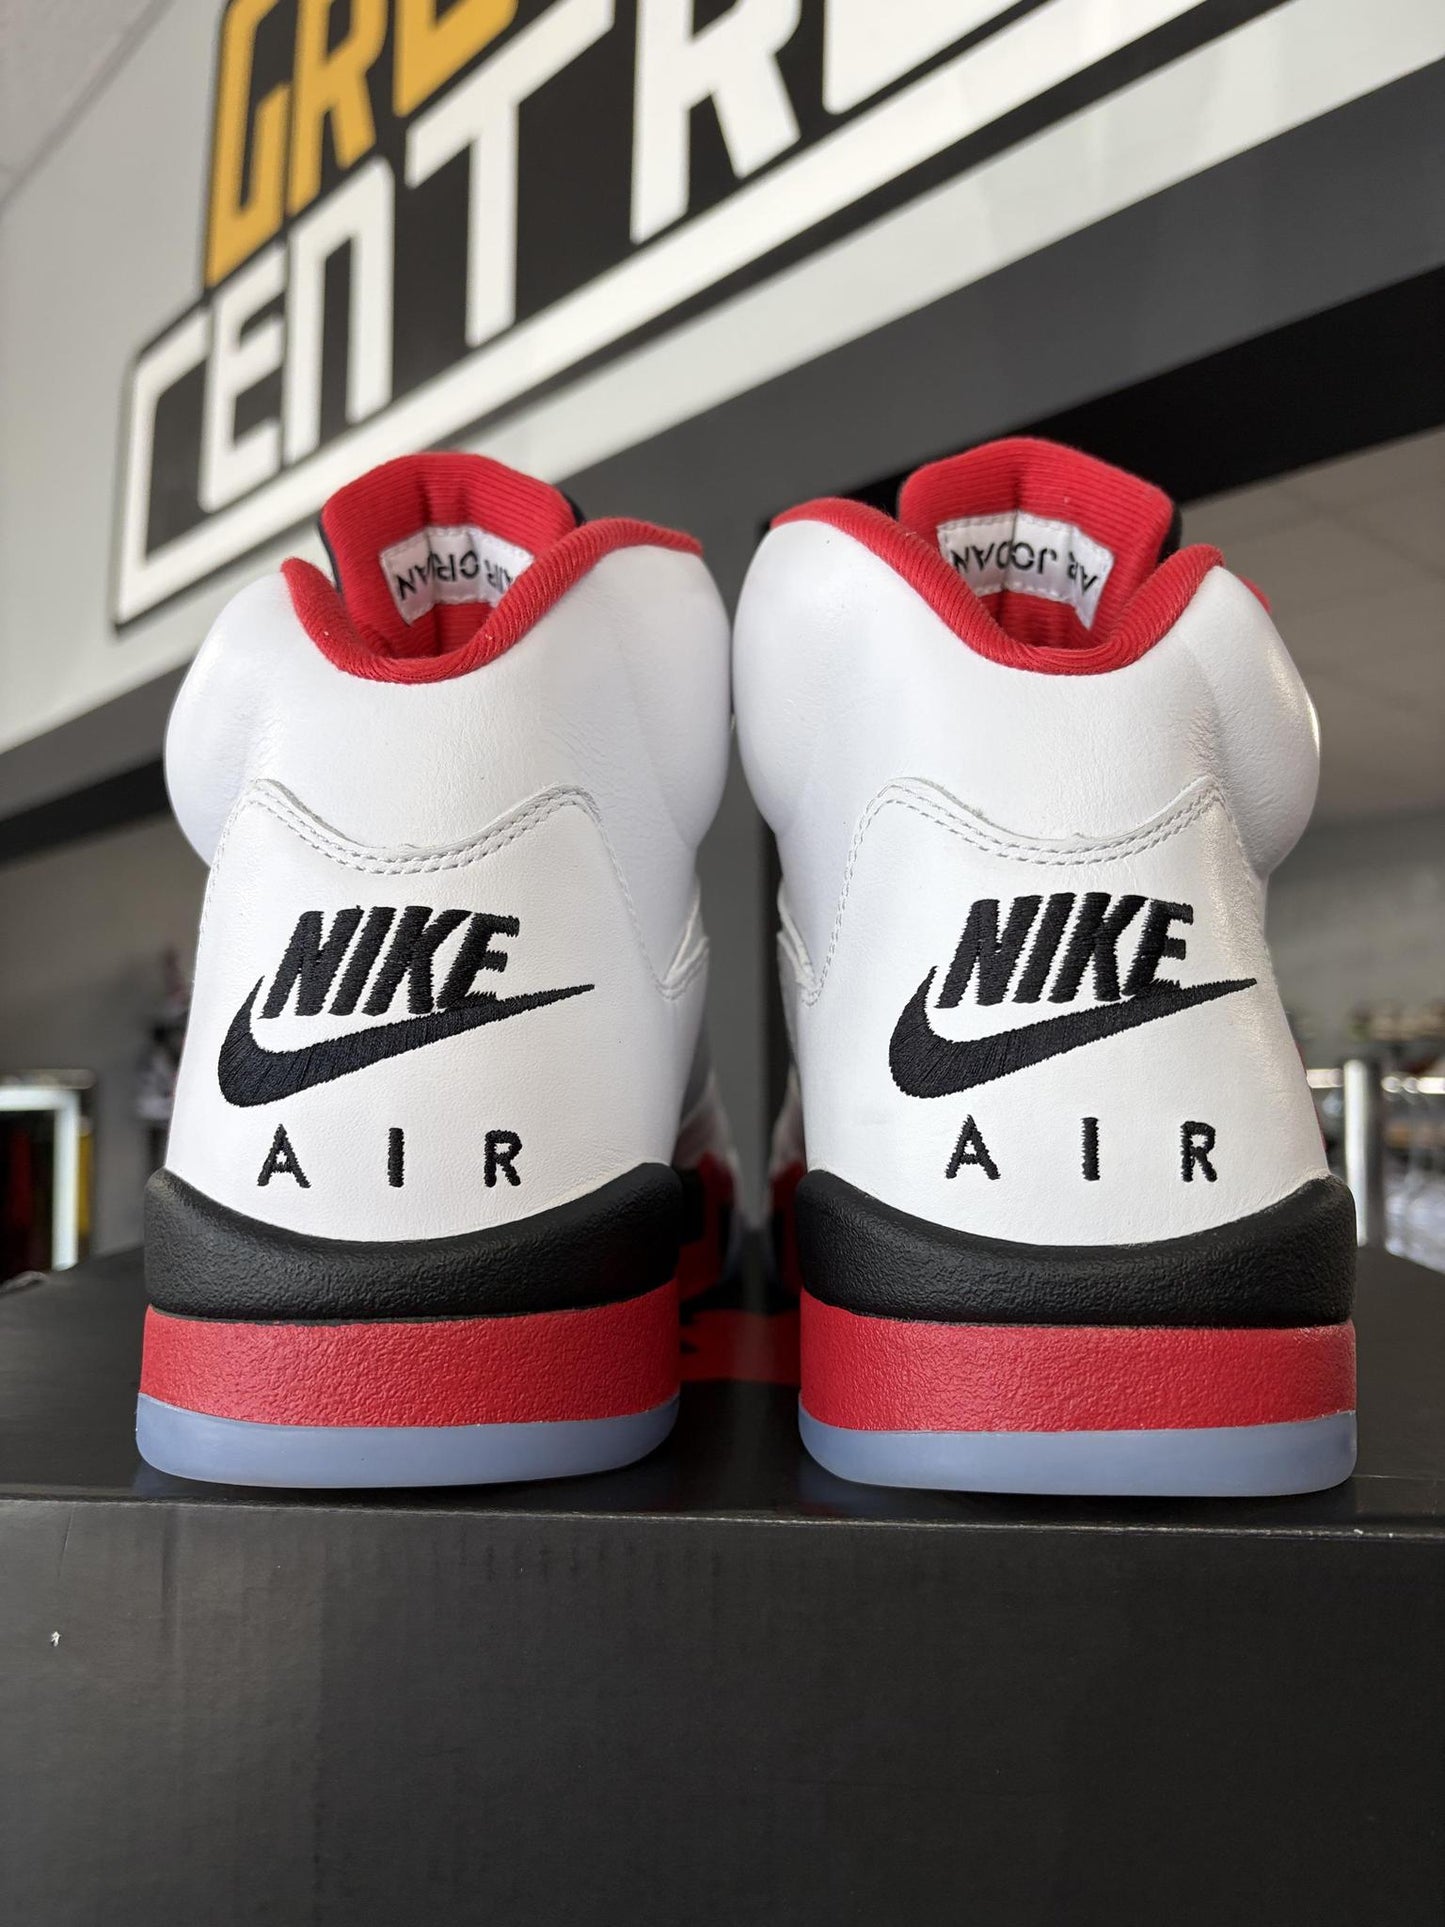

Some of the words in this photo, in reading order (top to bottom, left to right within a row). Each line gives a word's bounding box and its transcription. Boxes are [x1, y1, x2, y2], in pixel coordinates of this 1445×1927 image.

[950, 541, 1058, 575] JODAN
[257, 905, 521, 1019] NIKE
[934, 892, 1194, 1009] NIKE
[257, 1124, 522, 1188] AIR
[945, 1114, 1218, 1182] AIR
